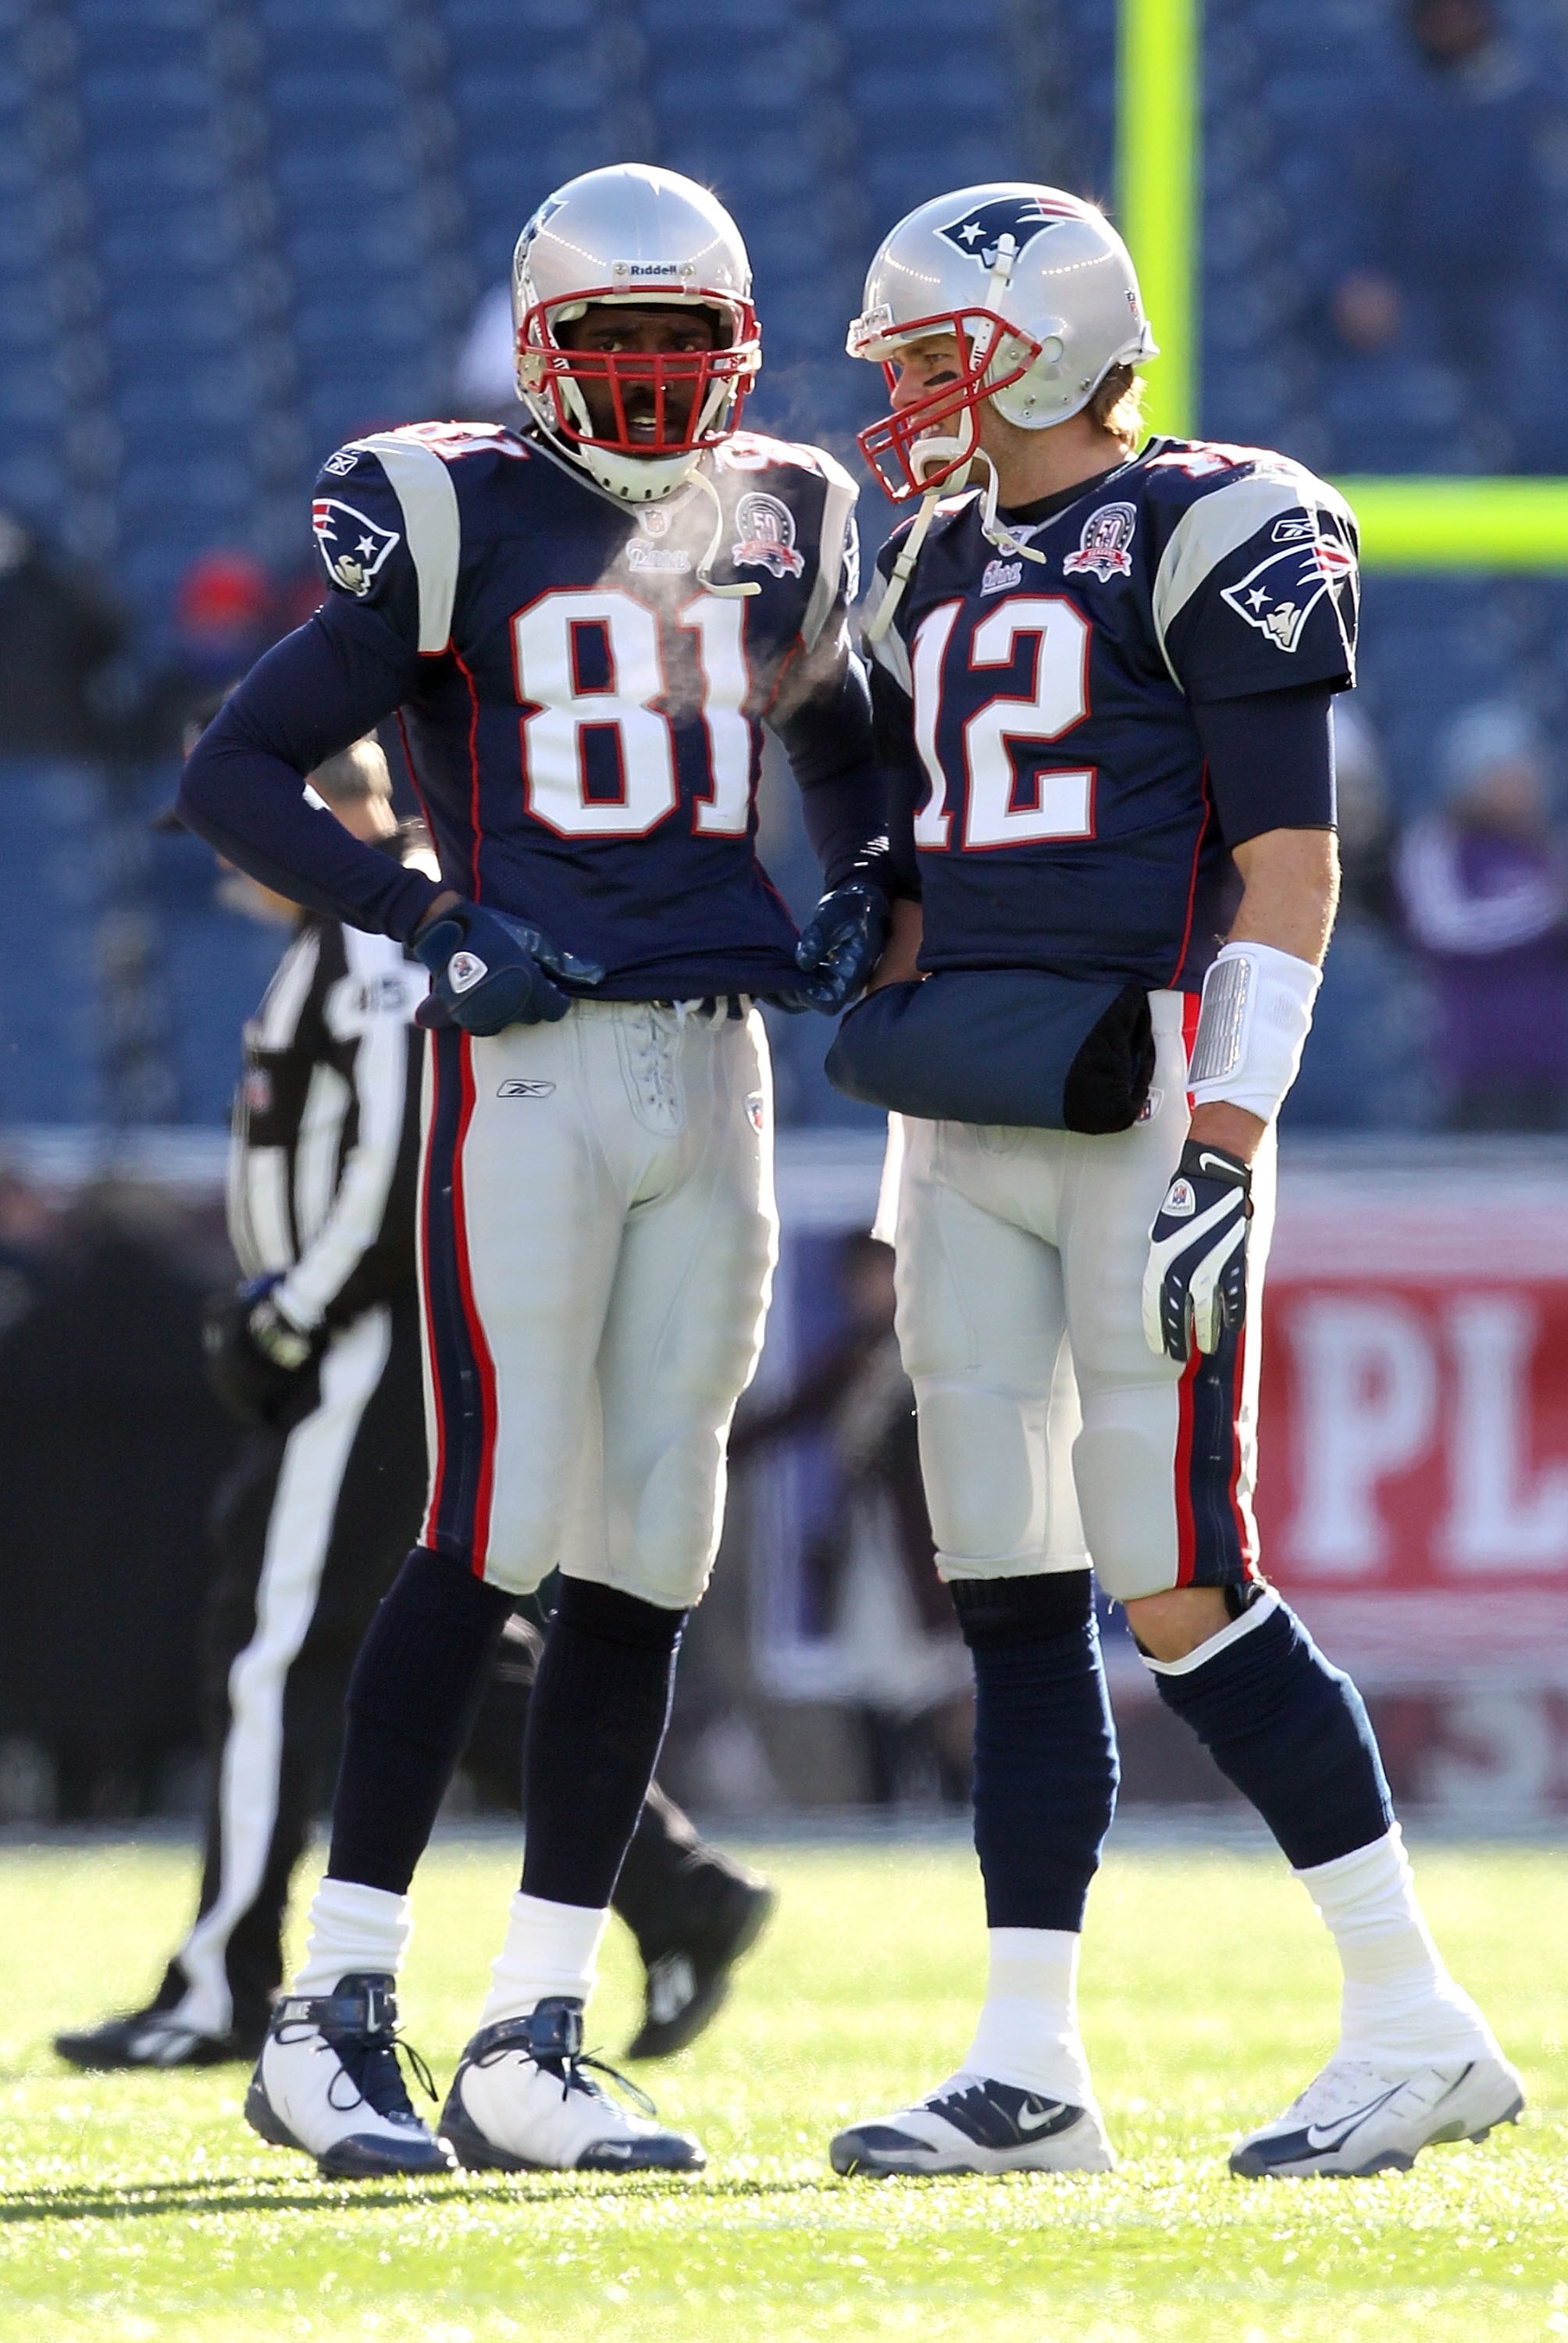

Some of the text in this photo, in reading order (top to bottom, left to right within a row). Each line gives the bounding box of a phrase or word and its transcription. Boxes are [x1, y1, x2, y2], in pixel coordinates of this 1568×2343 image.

[630, 265, 677, 276] Riddell
[509, 586, 752, 839] 81
[912, 593, 1097, 853] 12
